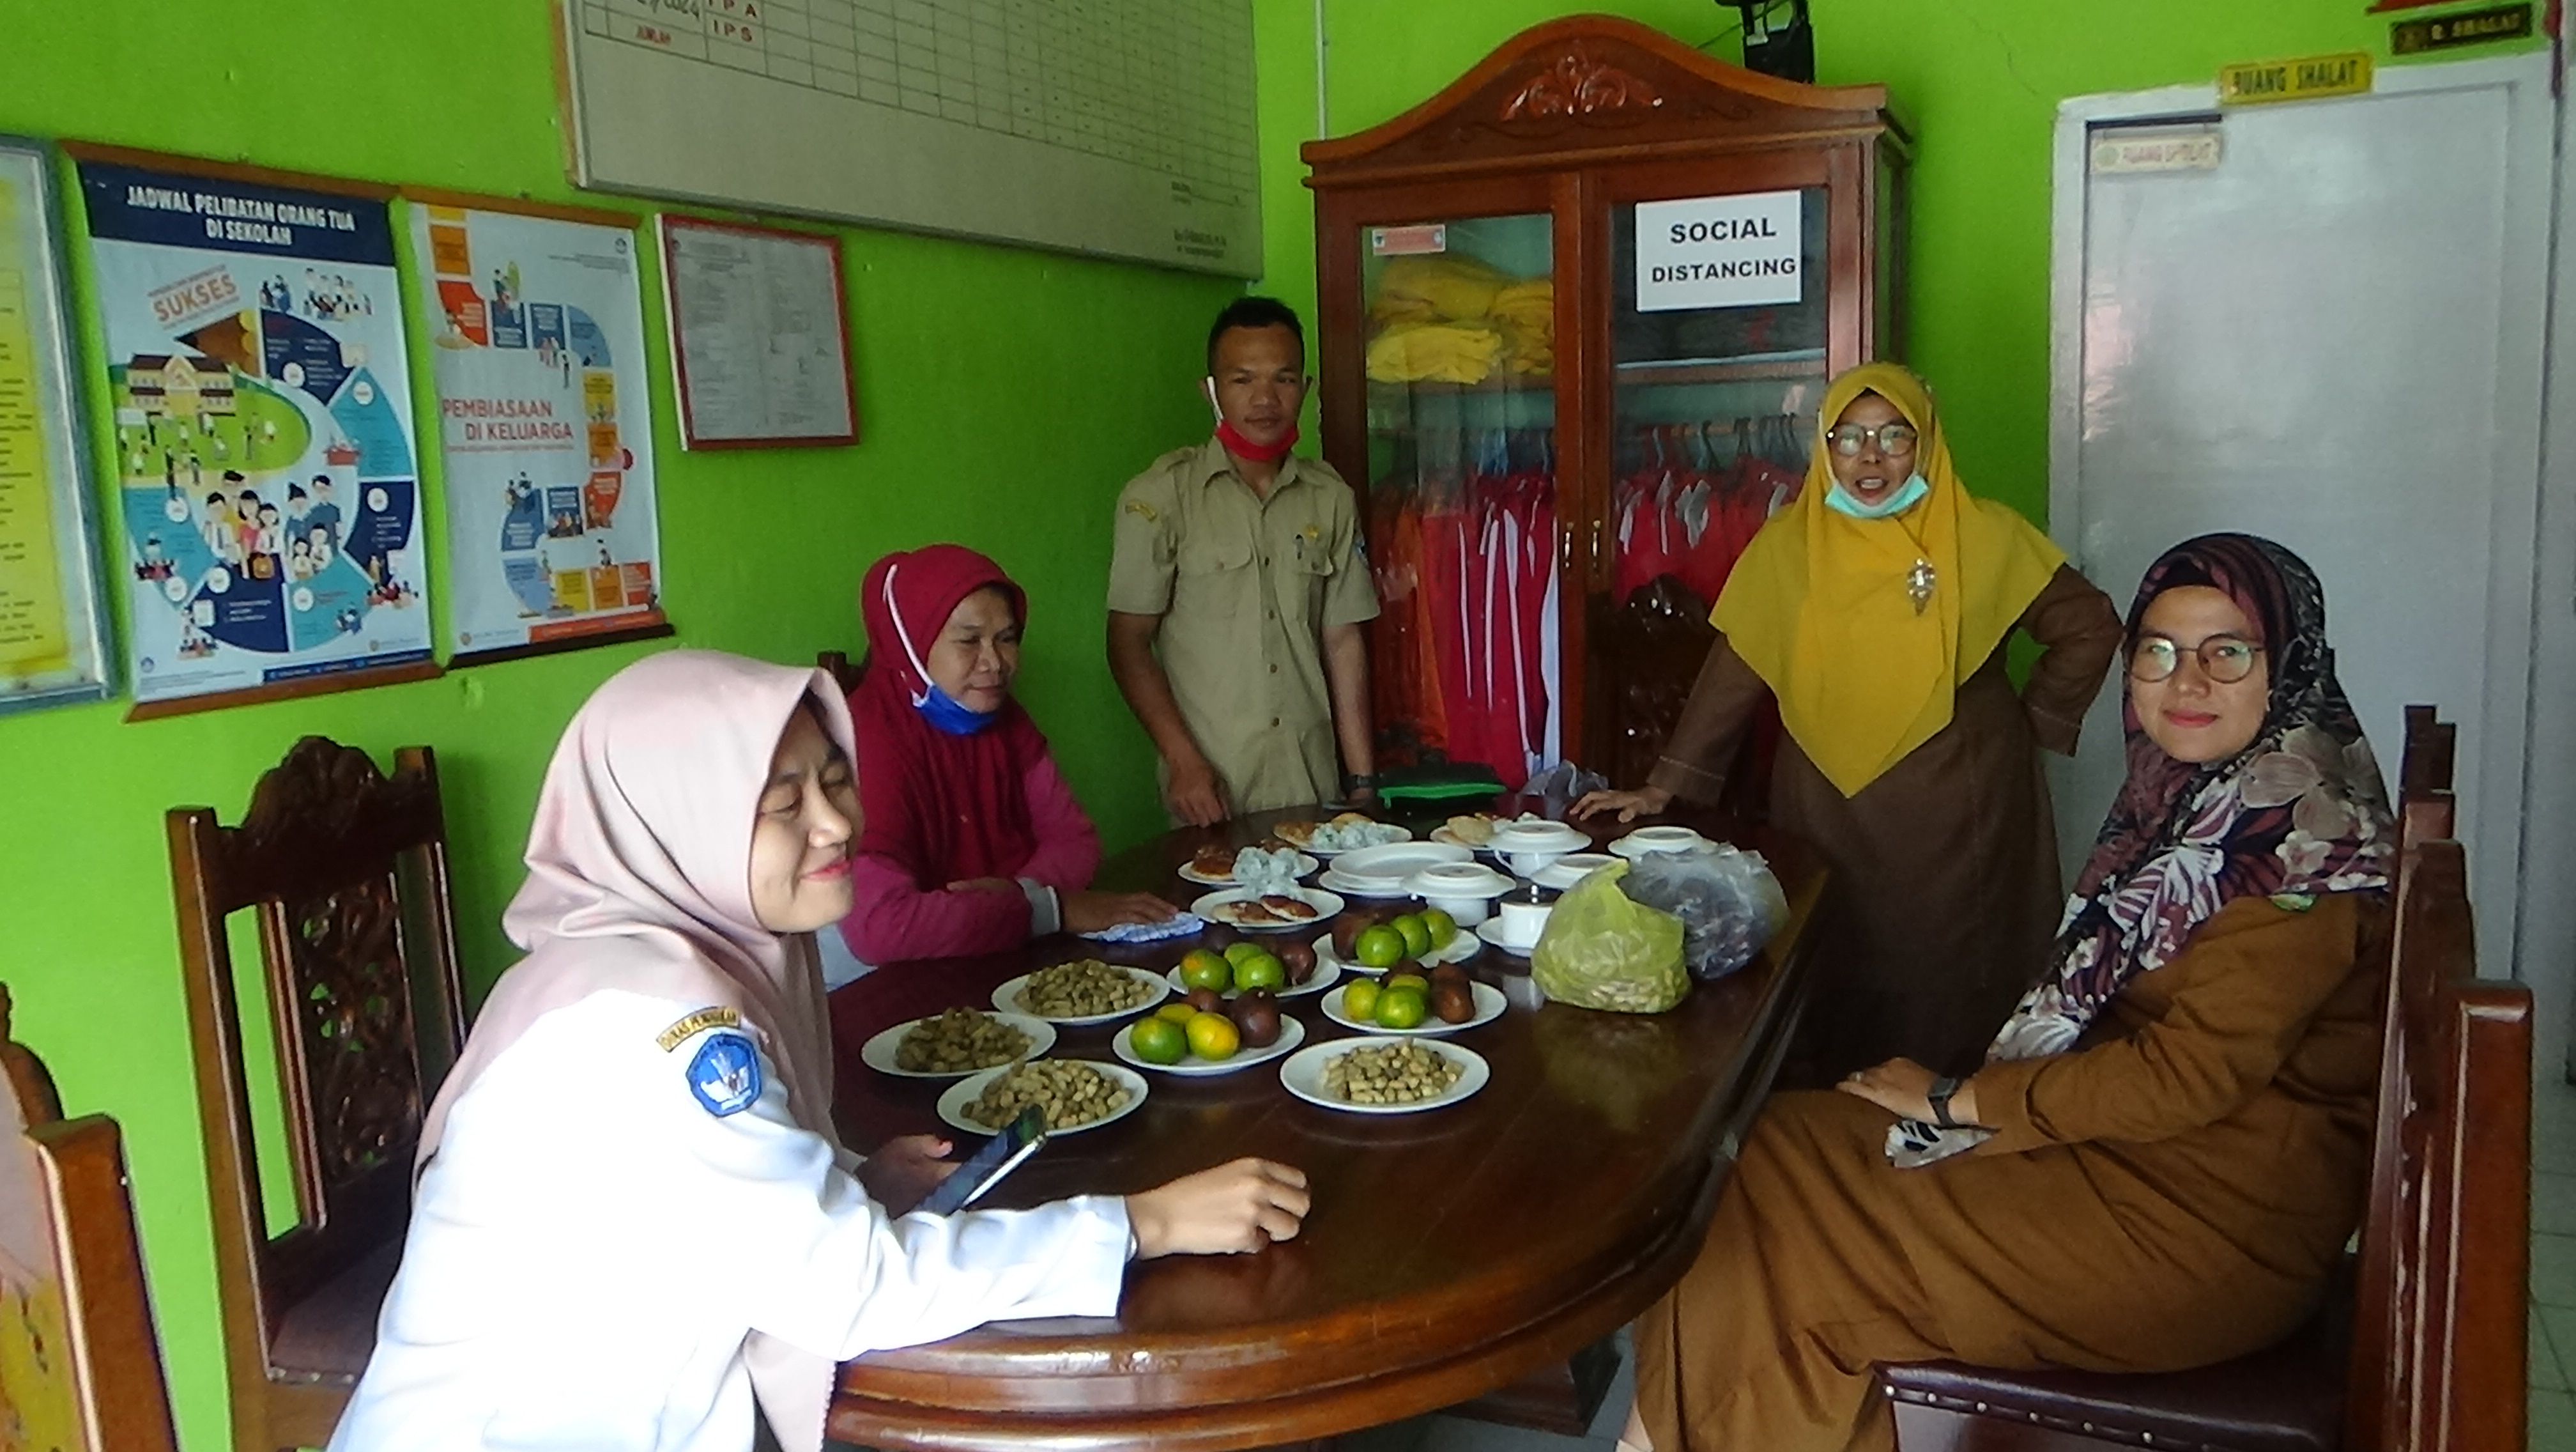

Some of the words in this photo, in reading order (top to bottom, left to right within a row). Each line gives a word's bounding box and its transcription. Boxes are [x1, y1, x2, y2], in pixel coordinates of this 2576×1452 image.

[2297, 60, 2358, 89] SHALAT
[127, 185, 192, 212] JADWAL
[194, 193, 275, 221] PELIBATAN
[277, 203, 326, 228] ORANG
[328, 210, 355, 231] TUA
[206, 218, 224, 238] DI
[226, 220, 292, 245] SEKOLAH
[1670, 217, 1777, 244] SOCIAL
[1652, 258, 1795, 282] DISTANCING
[153, 274, 236, 320] SUKSES
[442, 399, 552, 417] PEMBIASAAN
[465, 422, 482, 440] DI
[487, 422, 574, 440] KELUARGA
